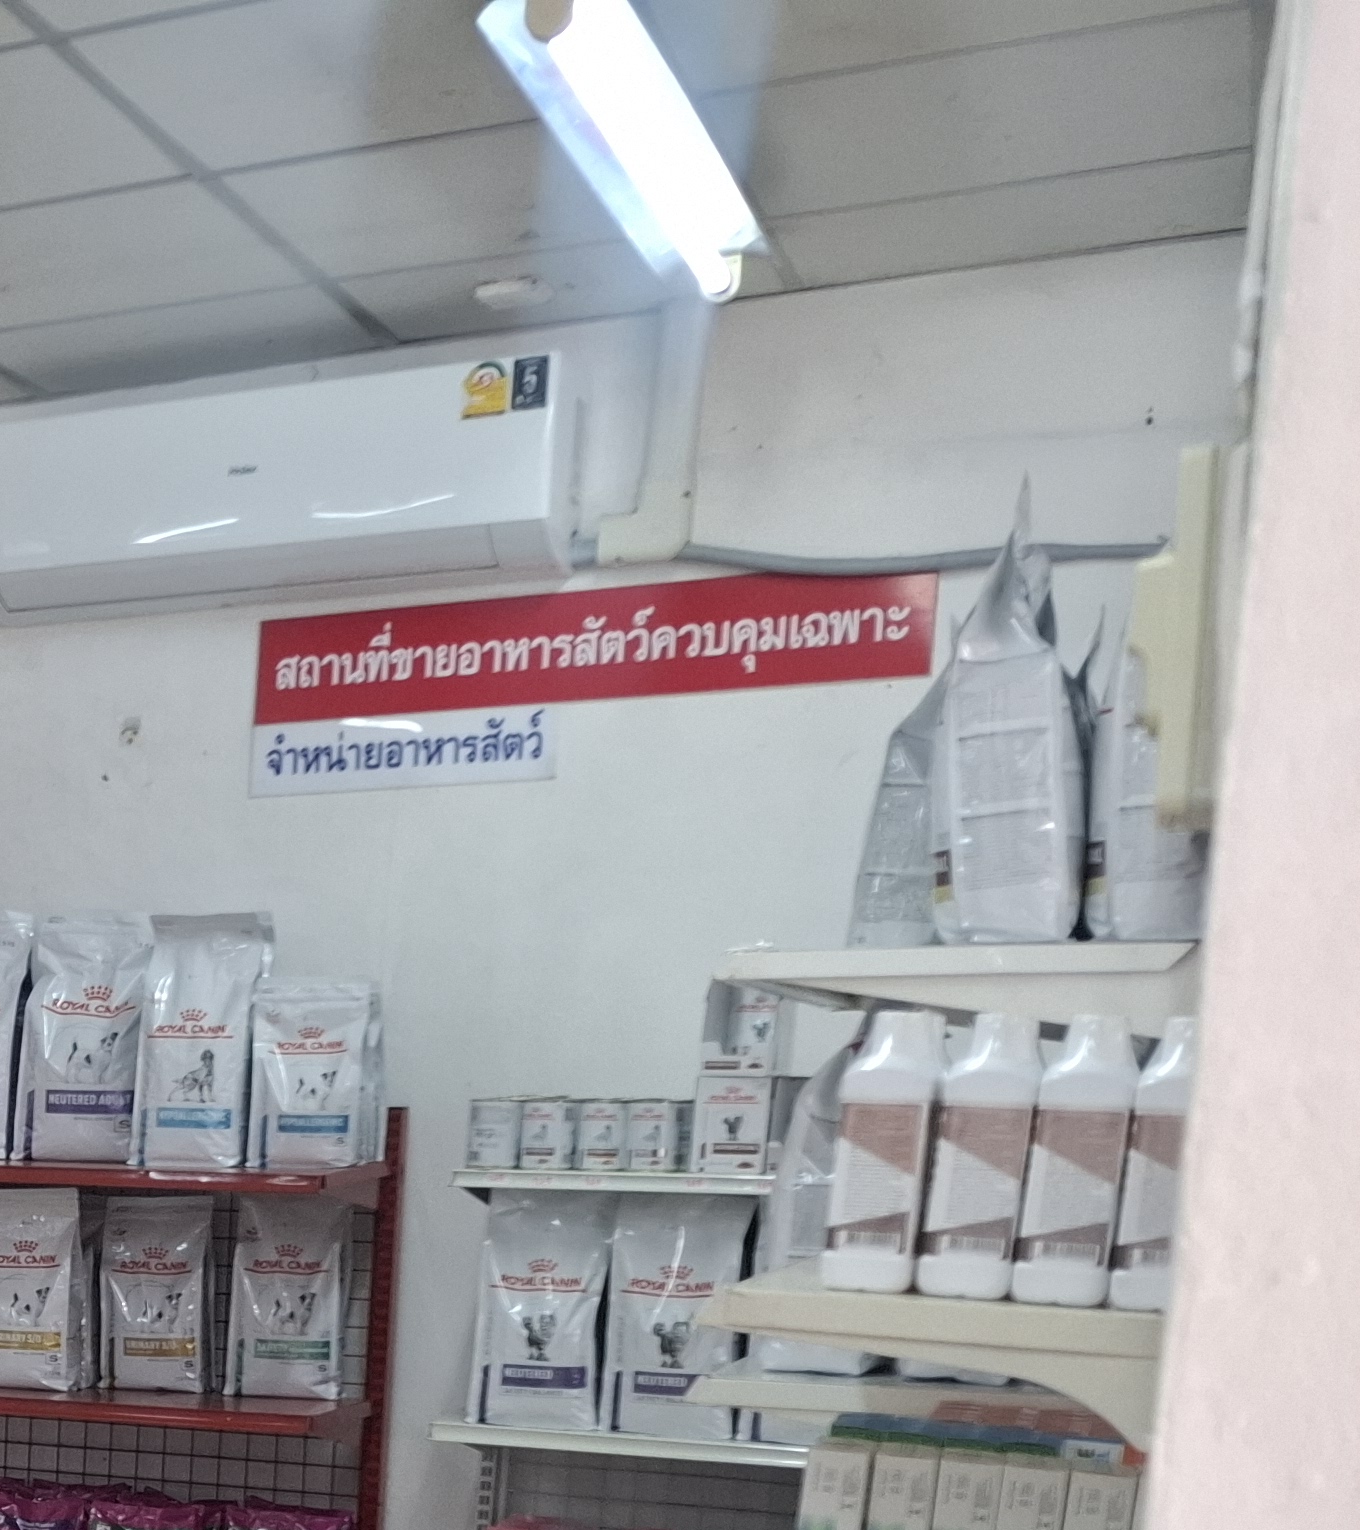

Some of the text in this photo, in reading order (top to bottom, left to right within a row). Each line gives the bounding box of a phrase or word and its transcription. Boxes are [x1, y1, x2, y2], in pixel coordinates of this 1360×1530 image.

[275, 603, 911, 692] สถานที่ขายอาหารสัตว์ควบคุมเฉพาะ
[266, 711, 546, 778] จำหน่ายอาหารสัตว์
[154, 1024, 227, 1035] ROYAL CANIN
[48, 1094, 97, 1105] NEUTERED
[24, 1254, 57, 1264] CANIN
[253, 1259, 322, 1270] ROYAL CANIN
[120, 1260, 188, 1270] ROYAL CANIN
